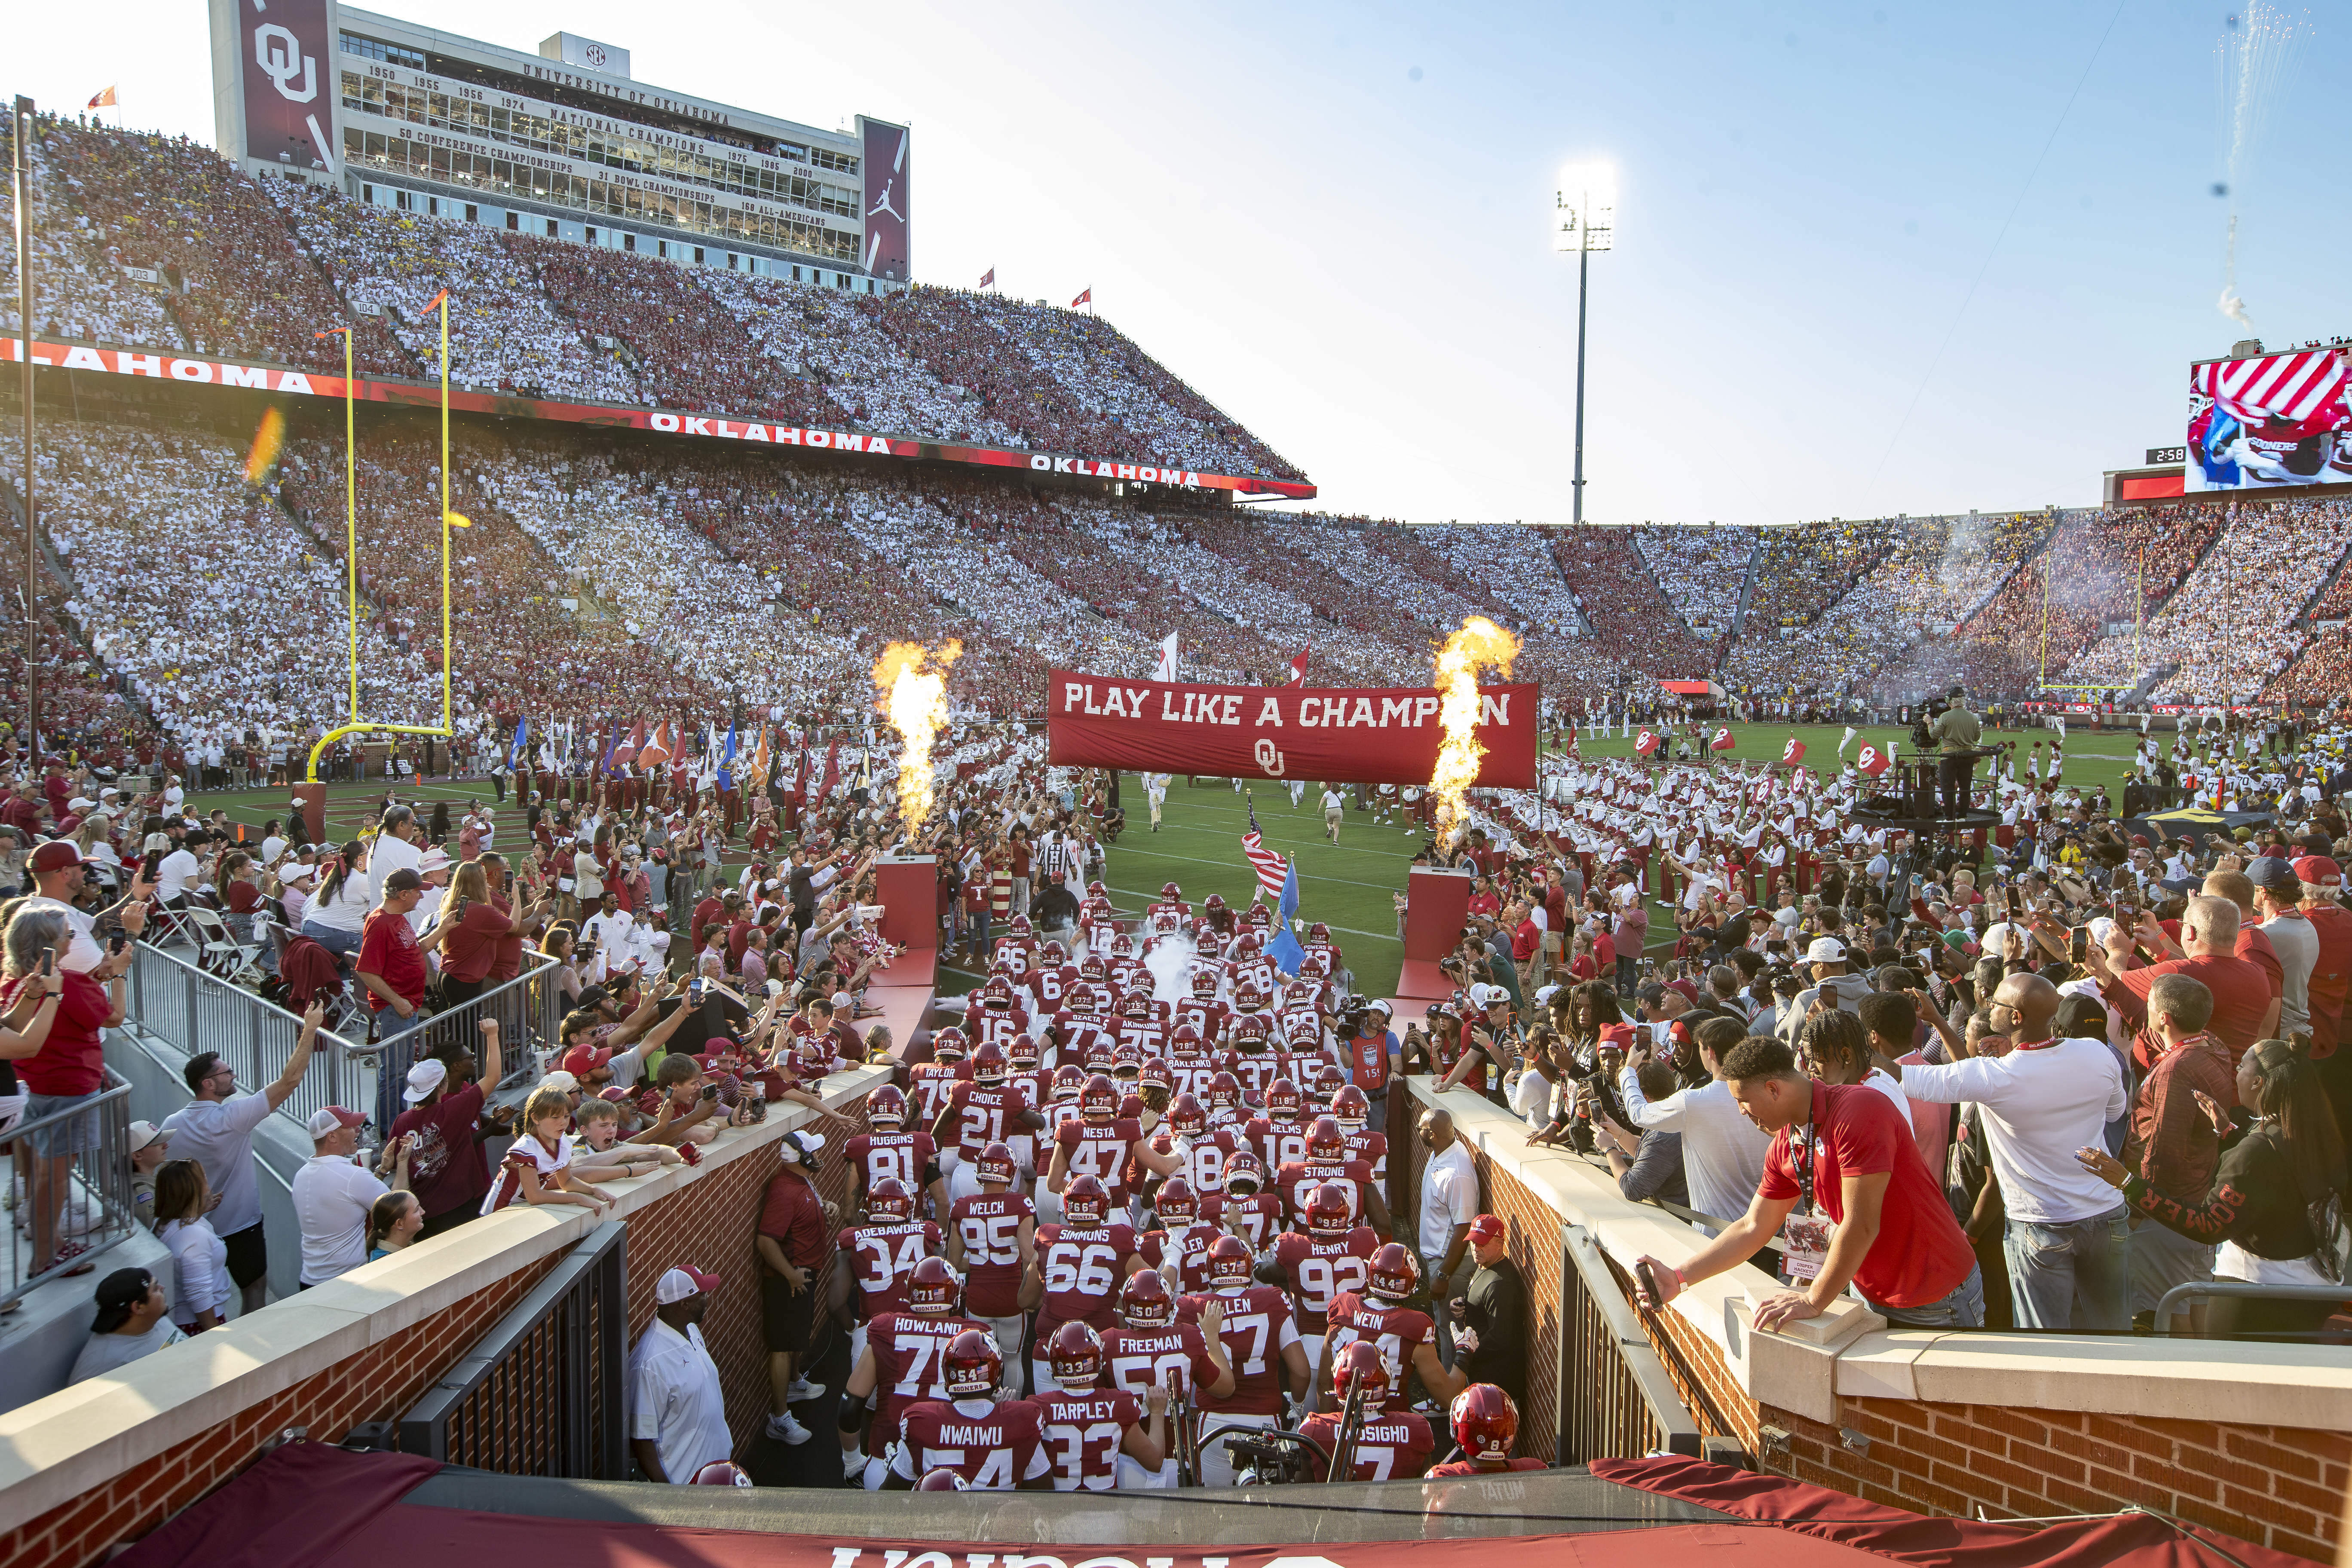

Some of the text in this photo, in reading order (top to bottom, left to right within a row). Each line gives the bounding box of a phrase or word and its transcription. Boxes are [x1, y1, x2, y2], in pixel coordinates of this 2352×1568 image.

[255, 23, 317, 103] OU
[587, 45, 605, 66] SEC
[524, 64, 729, 125] UNIVERSITY OF OKLAHOMA
[370, 65, 812, 178] 1950 1955 1956 1974 NATIONAL CHAMPIONS 1975 1985 2000
[418, 132, 486, 155] CONFERENCE
[491, 148, 573, 173] CHAMPIONSHIPS
[599, 172, 715, 203] 31 BOWL CHAMPIONSHIPS
[759, 205, 825, 226] ALL-AMERICANS
[0, 338, 314, 395] LAHOMA
[651, 413, 891, 454] OKLAHOMA
[2157, 449, 2184, 462] 2:58
[1031, 455, 1201, 487] OKLAHOMA
[1064, 682, 1510, 728] PLAY LIKE A CHAMPN
[1635, 731, 1652, 751] OU
[1254, 738, 1285, 776] OU
[1858, 747, 1876, 769] OU
[1793, 768, 1803, 790] OU
[976, 888, 982, 900] 1
[1089, 926, 1115, 952] 12
[1237, 958, 1266, 970] HEINECKE
[1042, 972, 1061, 1000] 6
[1182, 998, 1208, 1007] HAWKINS
[1289, 1004, 1315, 1013] JORDAN
[986, 1010, 1011, 1019] OKOYE
[1073, 1015, 1100, 1023] OZAETA
[980, 1018, 1015, 1049] 16
[1122, 1020, 1161, 1031] AKINKUNMI
[2029, 1040, 2049, 1048] OKLAHOMA
[1247, 1053, 1277, 1061] HAWKINS
[925, 1069, 956, 1078] TAYLOR
[1237, 1061, 1278, 1090] 37
[1288, 1060, 1324, 1092] 15
[969, 1091, 1003, 1106] CHOICE
[1279, 1096, 1289, 1105] 18
[879, 1104, 888, 1113] 81
[961, 1105, 1003, 1148] 21
[1083, 1127, 1115, 1138] NESTA
[1270, 1124, 1301, 1134] HELMS
[870, 1134, 914, 1145] HUGGINS
[867, 1146, 918, 1193] 81
[985, 1162, 999, 1172] 95
[1069, 1140, 1127, 1186] 47
[1792, 1148, 1800, 1173] OKLAHOMA
[1305, 1167, 1344, 1177] STRONG
[877, 1201, 891, 1210] 34
[970, 1201, 1004, 1215] WELCH
[1167, 1204, 1181, 1213] 43
[1222, 1199, 1258, 1211] MRTIN
[1323, 1217, 1337, 1227] 92
[855, 1223, 925, 1242] ADEBAWORE
[961, 1215, 1019, 1265] 95
[1059, 1229, 1110, 1242] SIMMONS
[1312, 1241, 1349, 1256] HENRY
[856, 1234, 925, 1292] 34
[1046, 1243, 1116, 1296] 66
[1222, 1263, 1236, 1273] 57
[1794, 1266, 1815, 1275] HACKETT
[1299, 1256, 1366, 1311] 92
[1379, 1279, 1395, 1289] 44
[919, 1290, 933, 1301] 71
[1374, 1290, 1400, 1298] SOONERS
[1136, 1307, 1152, 1317] 50
[1354, 1310, 1384, 1330] WEIN
[895, 1318, 962, 1335] HOWLAND
[1120, 1335, 1182, 1354] FREEMAN
[959, 1370, 977, 1382] 54
[1066, 1361, 1083, 1373] 33
[953, 1384, 983, 1392] SOONERS
[1112, 1353, 1191, 1417] 50
[1050, 1401, 1115, 1421] TARPLEY
[940, 1424, 1002, 1446] NWAIWU
[1491, 1440, 1499, 1451] 8
[1042, 1422, 1121, 1491] 33
[1355, 1446, 1394, 1482] 7
[1482, 1481, 1526, 1501] TATUM
